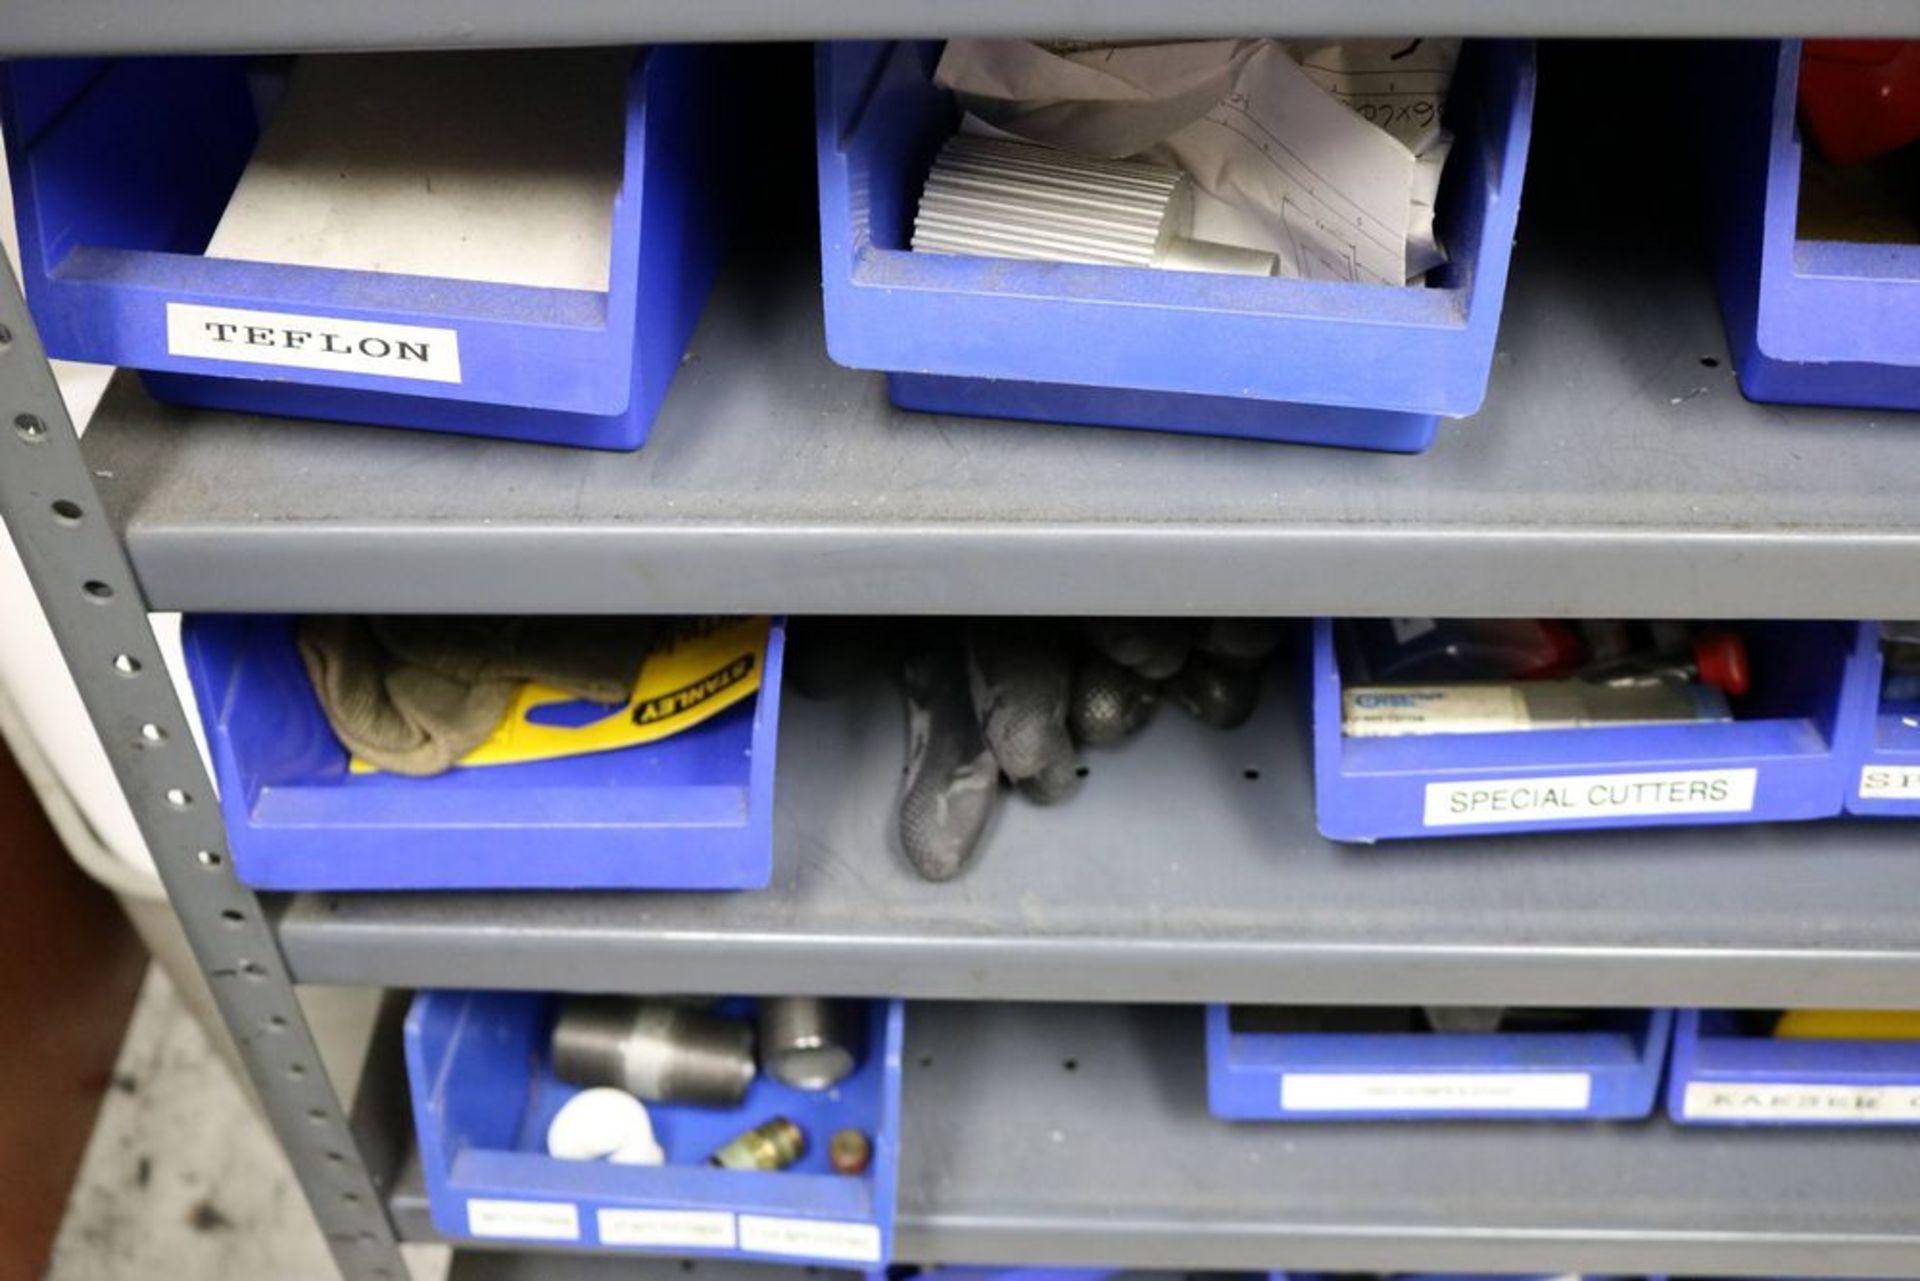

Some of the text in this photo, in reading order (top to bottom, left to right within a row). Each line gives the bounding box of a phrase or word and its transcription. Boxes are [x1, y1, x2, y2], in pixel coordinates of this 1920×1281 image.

[205, 322, 431, 362] TEFLON
[639, 658, 748, 722] STANLEY
[1450, 778, 1729, 814] SPECIAL CUTTERS
